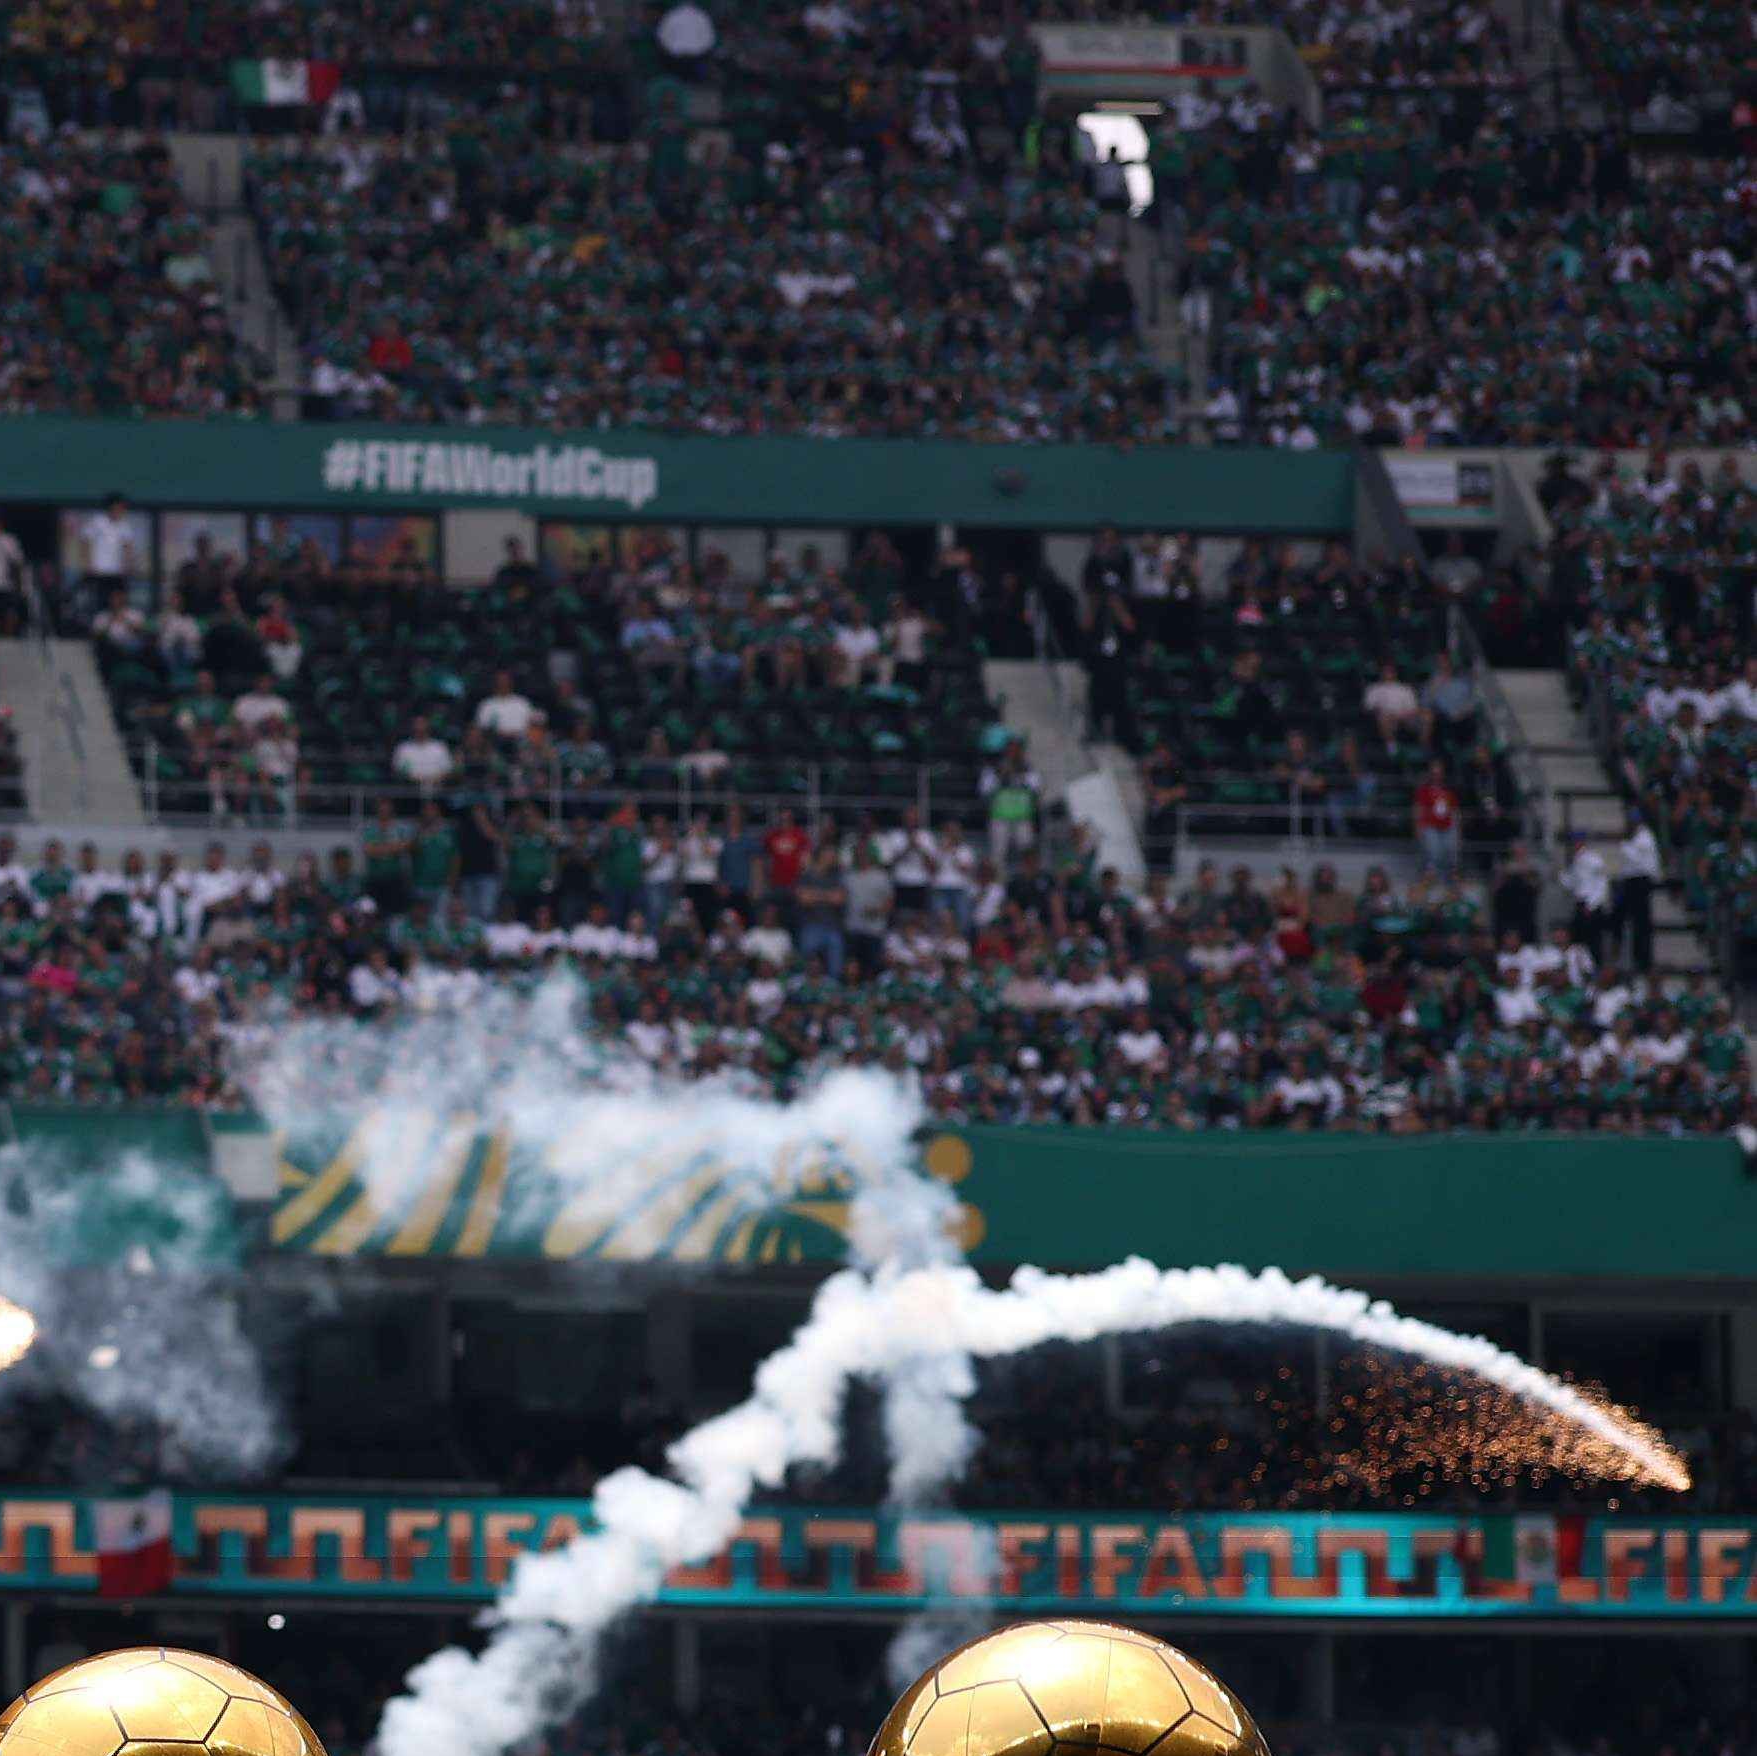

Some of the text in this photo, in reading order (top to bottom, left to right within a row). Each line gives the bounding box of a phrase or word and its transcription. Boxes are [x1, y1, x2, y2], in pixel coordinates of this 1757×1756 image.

[325, 439, 659, 511] #FIFAWorldCup
[1000, 1524, 1209, 1600] FIFA
[1604, 1528, 1757, 1604] FIF
